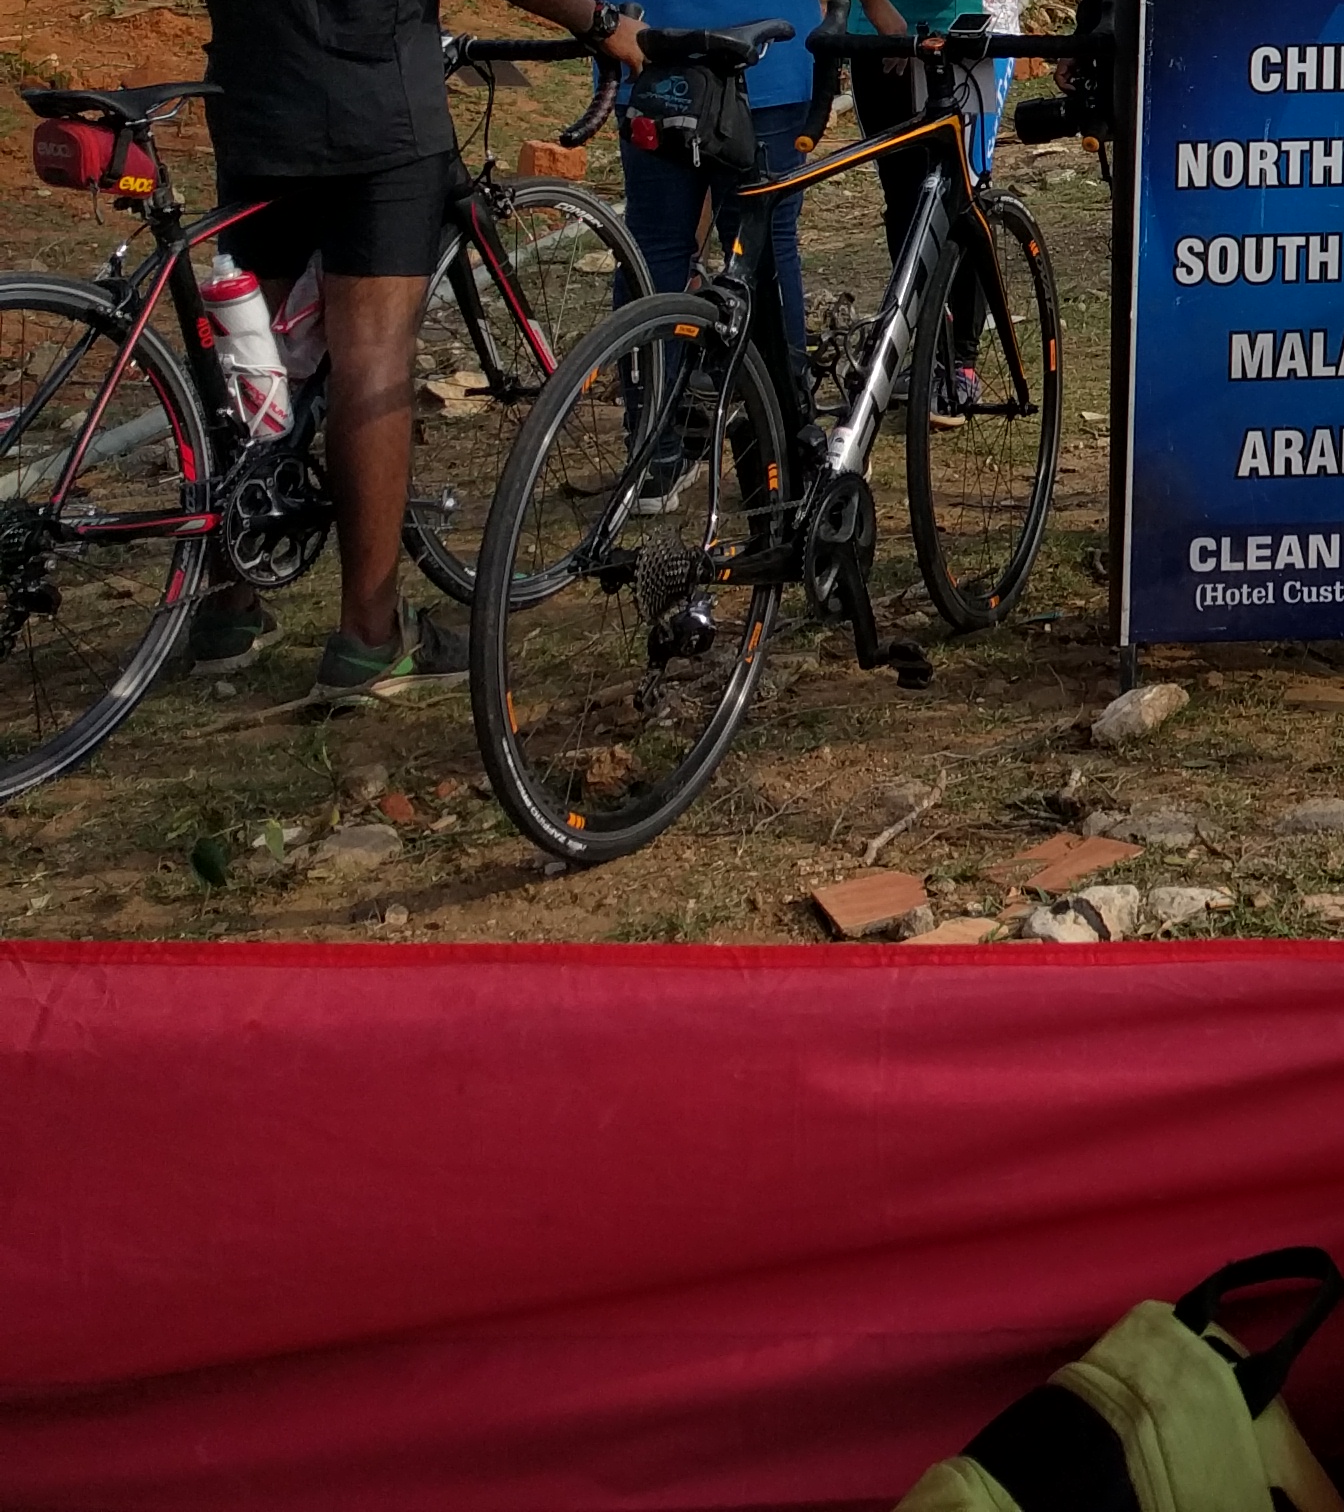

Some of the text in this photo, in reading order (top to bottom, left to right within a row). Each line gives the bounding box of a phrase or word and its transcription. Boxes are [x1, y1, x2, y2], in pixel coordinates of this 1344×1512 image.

[1177, 139, 1344, 188] NORTH
[1174, 235, 1340, 286] SOUTH
[1189, 534, 1341, 573] CLEAN
[1195, 582, 1276, 611] (Hotel
